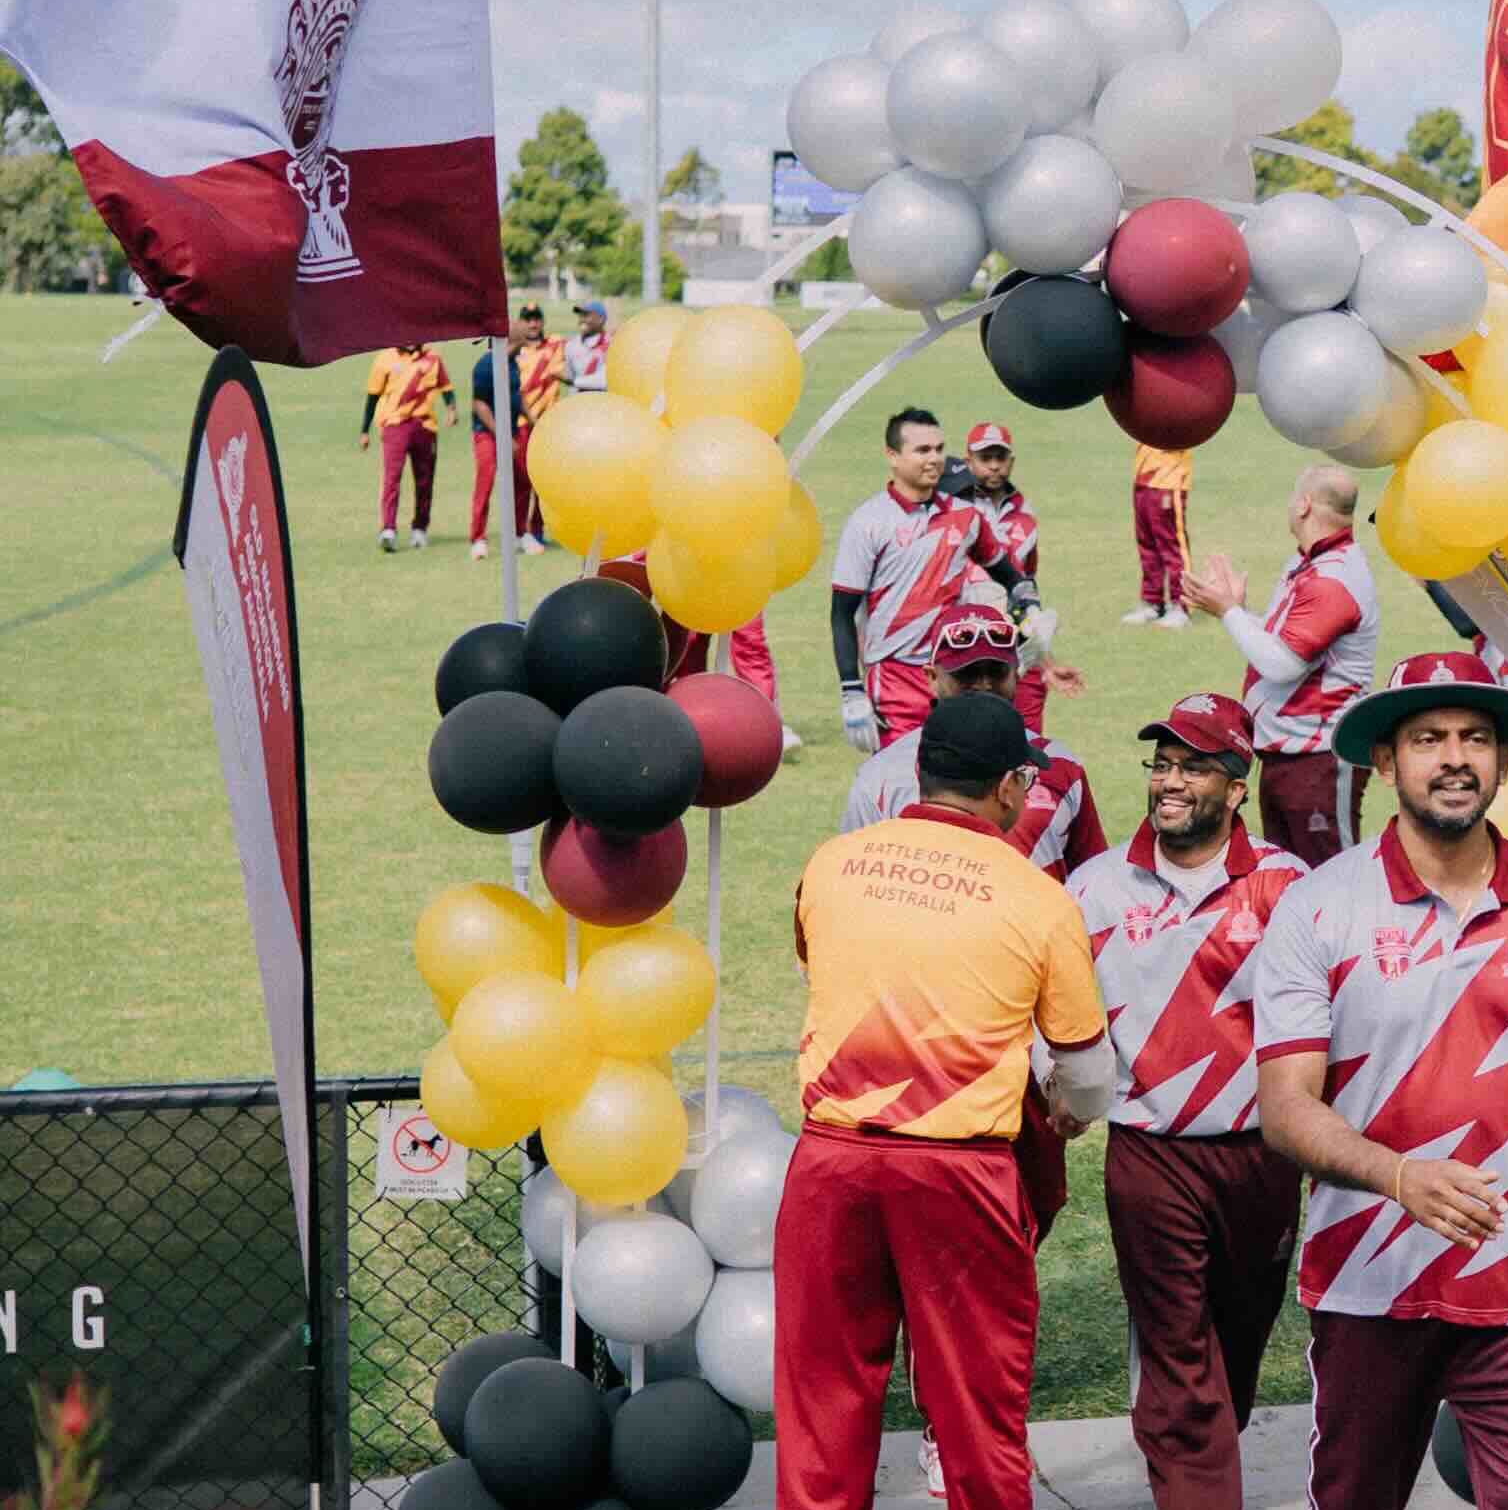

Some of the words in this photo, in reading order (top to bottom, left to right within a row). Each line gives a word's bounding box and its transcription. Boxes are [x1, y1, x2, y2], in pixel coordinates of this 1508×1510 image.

[864, 842, 923, 860] BATTLE
[928, 850, 952, 866] OF
[958, 857, 990, 875] THE
[841, 858, 993, 902] MAROONS
[863, 884, 956, 915] AUSTRALIA
